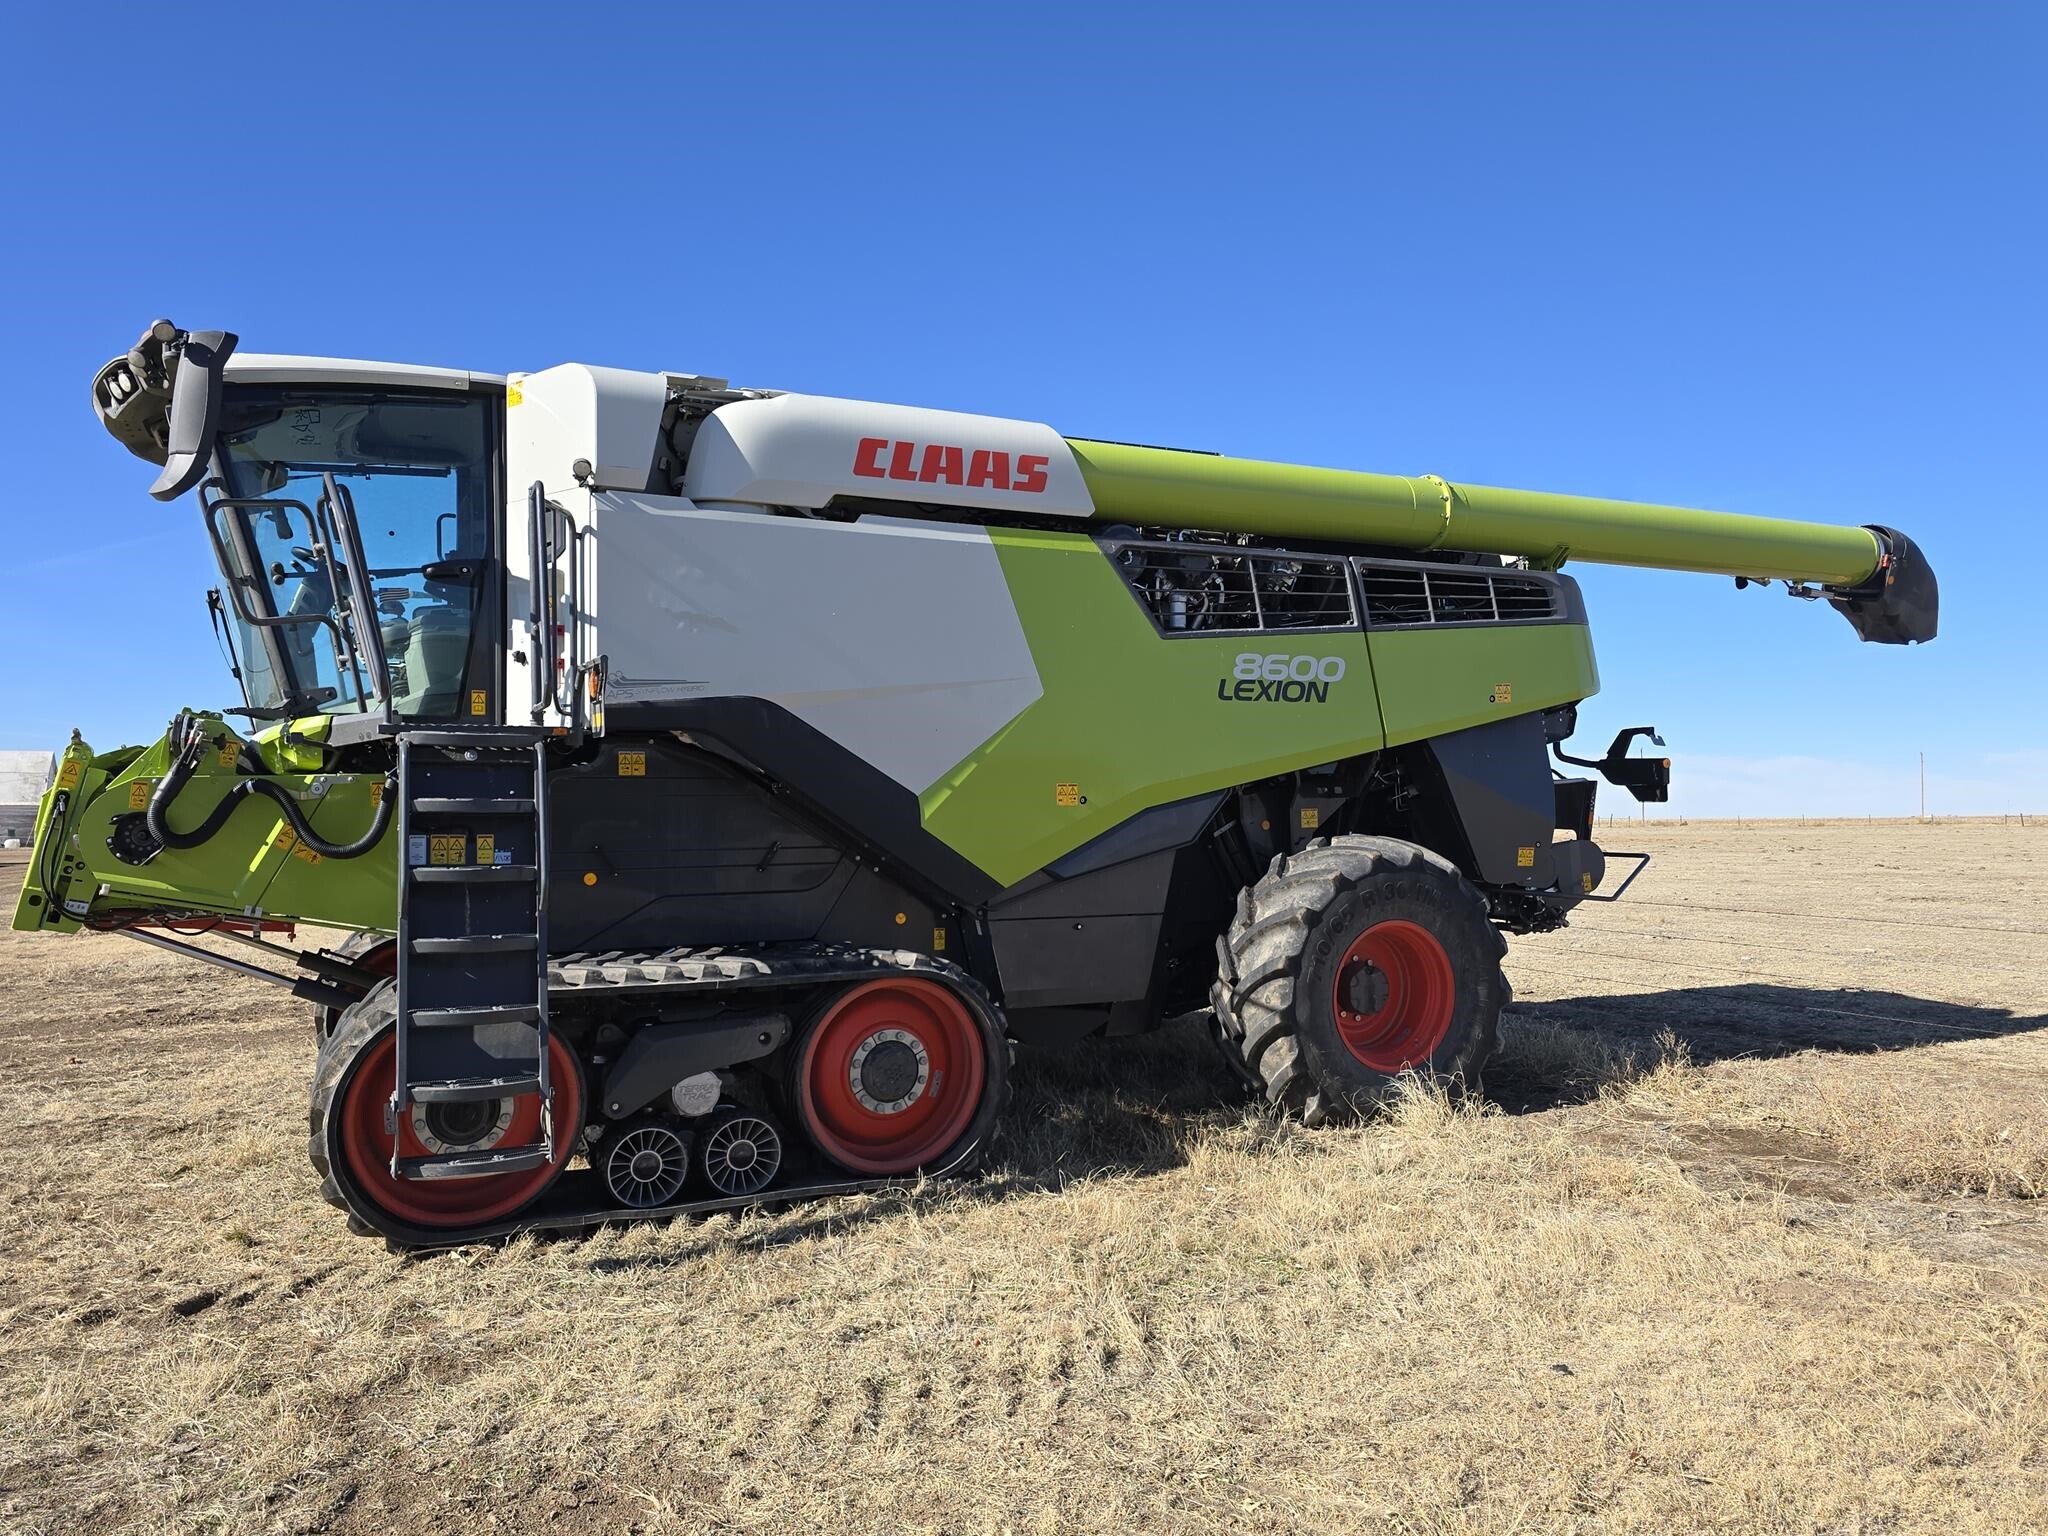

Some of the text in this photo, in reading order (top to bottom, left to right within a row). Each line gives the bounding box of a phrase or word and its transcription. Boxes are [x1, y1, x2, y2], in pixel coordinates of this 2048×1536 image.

[853, 437, 1050, 493] CLAAS
[1233, 652, 1346, 682] 8600
[606, 689, 634, 699] APS
[1218, 678, 1329, 703] LEXION
